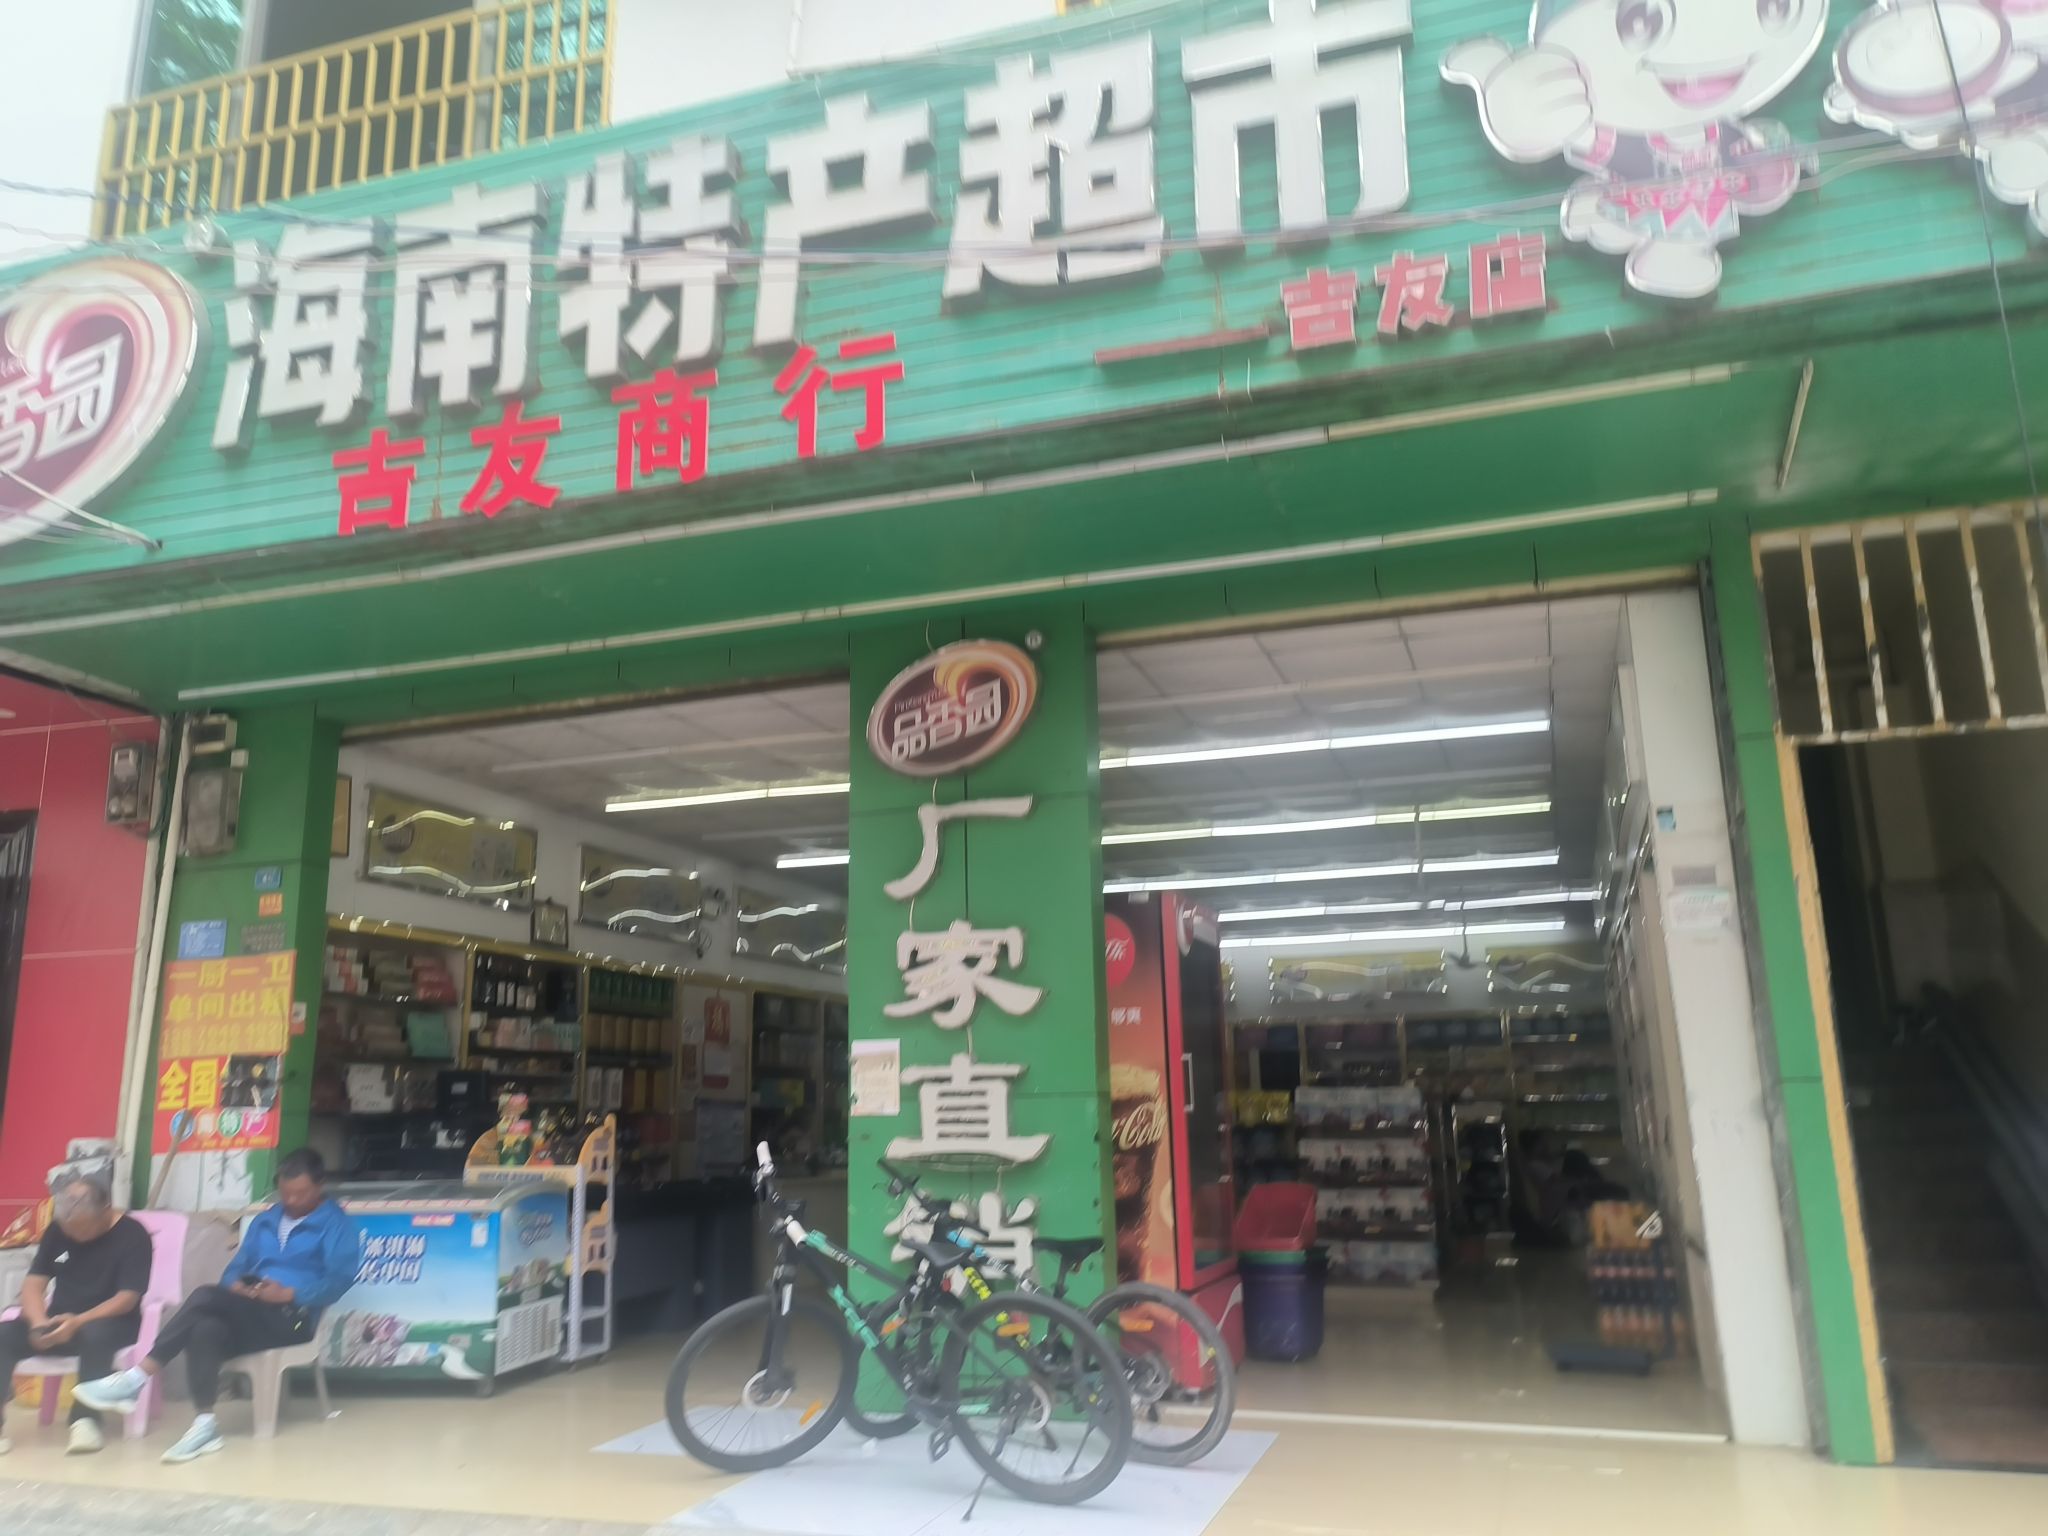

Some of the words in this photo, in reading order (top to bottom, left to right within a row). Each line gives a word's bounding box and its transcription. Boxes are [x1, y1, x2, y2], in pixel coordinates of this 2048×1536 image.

[212, 0, 1414, 452] 海南特产超市
[331, 331, 904, 535] 吉友商行
[158, 1056, 228, 1112] 全国
